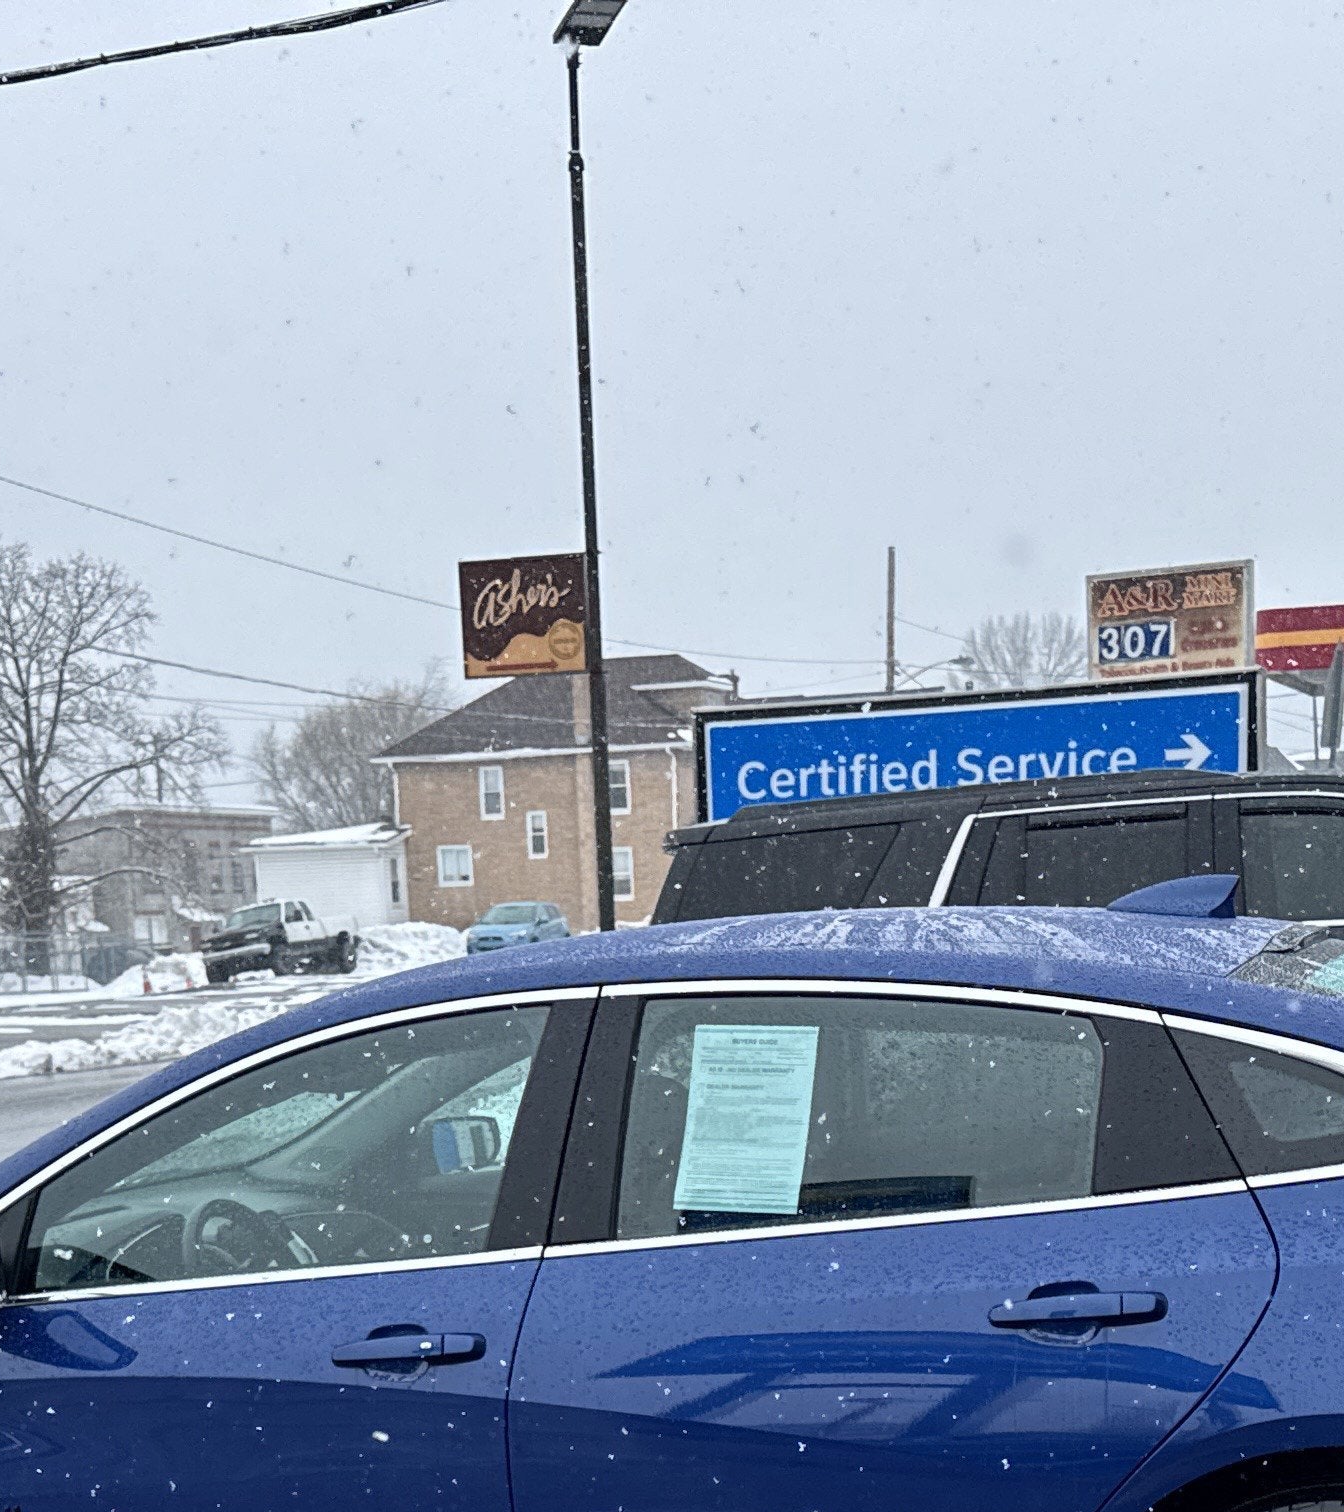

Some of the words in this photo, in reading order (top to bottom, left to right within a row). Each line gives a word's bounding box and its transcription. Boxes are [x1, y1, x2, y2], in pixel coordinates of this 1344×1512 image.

[1097, 579, 1178, 618] A&R
[1100, 624, 1168, 660] 307
[736, 749, 938, 800] Certified
[956, 741, 1138, 787] Service
